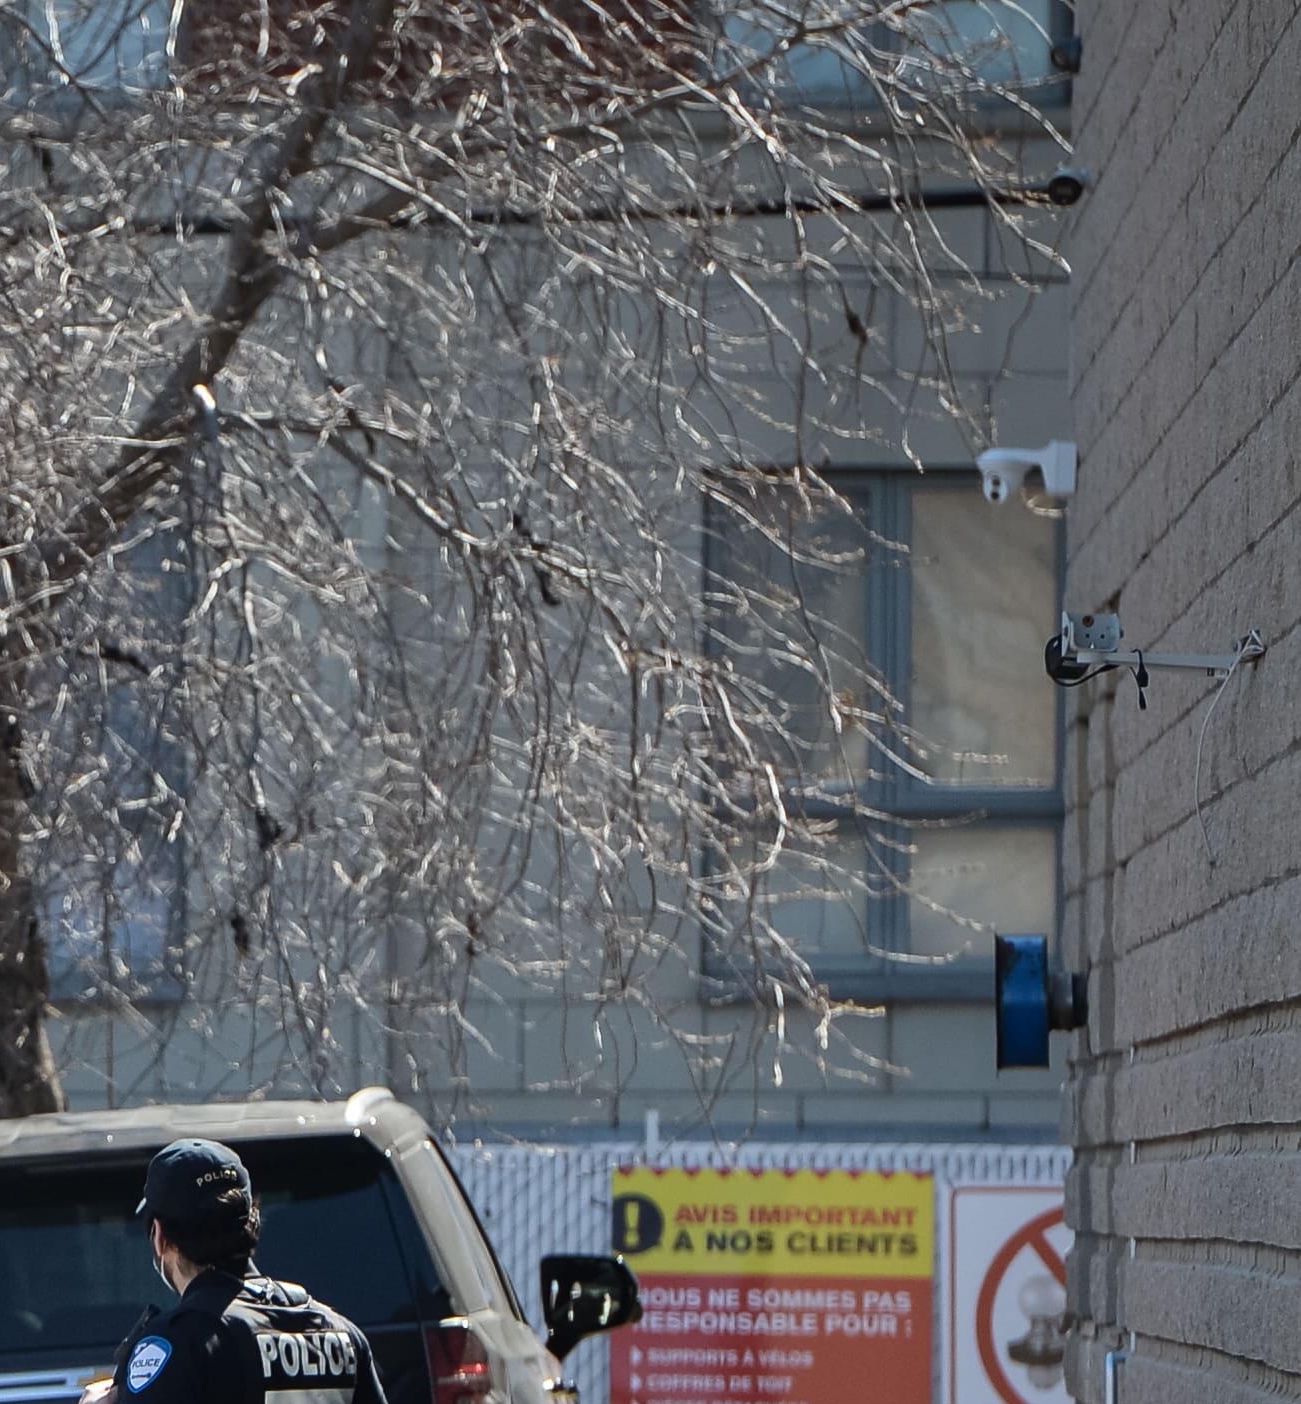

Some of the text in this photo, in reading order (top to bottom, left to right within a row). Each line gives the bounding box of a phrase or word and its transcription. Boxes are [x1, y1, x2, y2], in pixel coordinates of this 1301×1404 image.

[196, 1169, 238, 1187] POLICE
[674, 1203, 916, 1228] AVIS IMPORTANT
[706, 1231, 774, 1252] NOS
[786, 1232, 917, 1256] CLIENTS
[708, 1289, 740, 1309] NE
[746, 1289, 856, 1311] SOMMES
[862, 1291, 911, 1314] PAS
[825, 1314, 897, 1338] POUR
[131, 1358, 161, 1369] POLICE
[256, 1331, 358, 1378] POLICE
